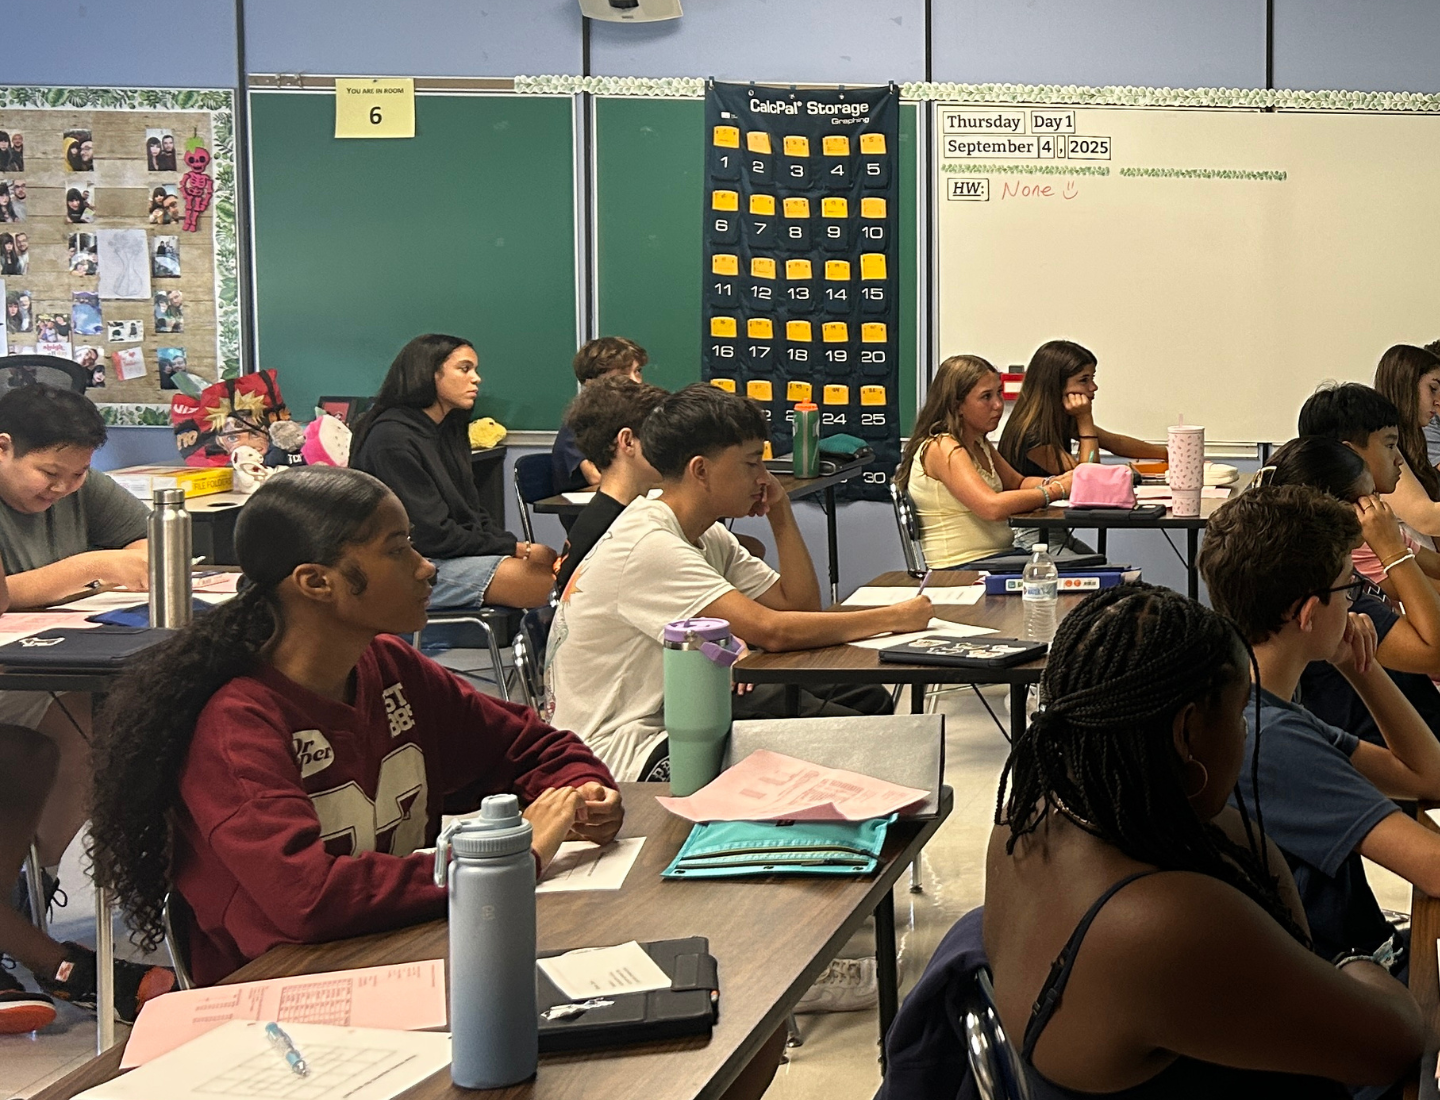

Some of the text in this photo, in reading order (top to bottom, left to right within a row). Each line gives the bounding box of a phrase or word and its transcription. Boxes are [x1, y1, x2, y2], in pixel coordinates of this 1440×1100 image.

[807, 101, 869, 116] Storage
[370, 106, 383, 125] 6
[831, 117, 870, 125] Graphing
[947, 115, 1073, 132] Thursday Day 1
[948, 140, 1034, 158] September
[1041, 142, 1052, 154] 4
[1070, 141, 1109, 155] 2025
[720, 156, 728, 169] 1
[752, 161, 764, 173] 2
[790, 165, 804, 177] 3
[830, 165, 845, 176] 4
[866, 163, 881, 176] 5
[952, 181, 985, 197] HW:
[1002, 181, 1056, 200] None
[715, 220, 728, 232] 6
[754, 223, 767, 235] 7
[789, 227, 802, 239] 8
[827, 226, 841, 239] 9
[862, 227, 884, 239] 10
[714, 283, 732, 296] 11
[751, 286, 772, 300] 12
[787, 288, 810, 300] 13
[826, 289, 847, 301] 14
[862, 288, 884, 300] 15
[712, 345, 734, 358] 16
[749, 346, 771, 358] 17
[787, 349, 808, 361] 18
[825, 350, 848, 362] 19
[862, 351, 886, 363] 20
[822, 413, 847, 425] 24
[862, 414, 886, 425] 25
[863, 472, 886, 484] 30
[194, 481, 206, 491] FILE
